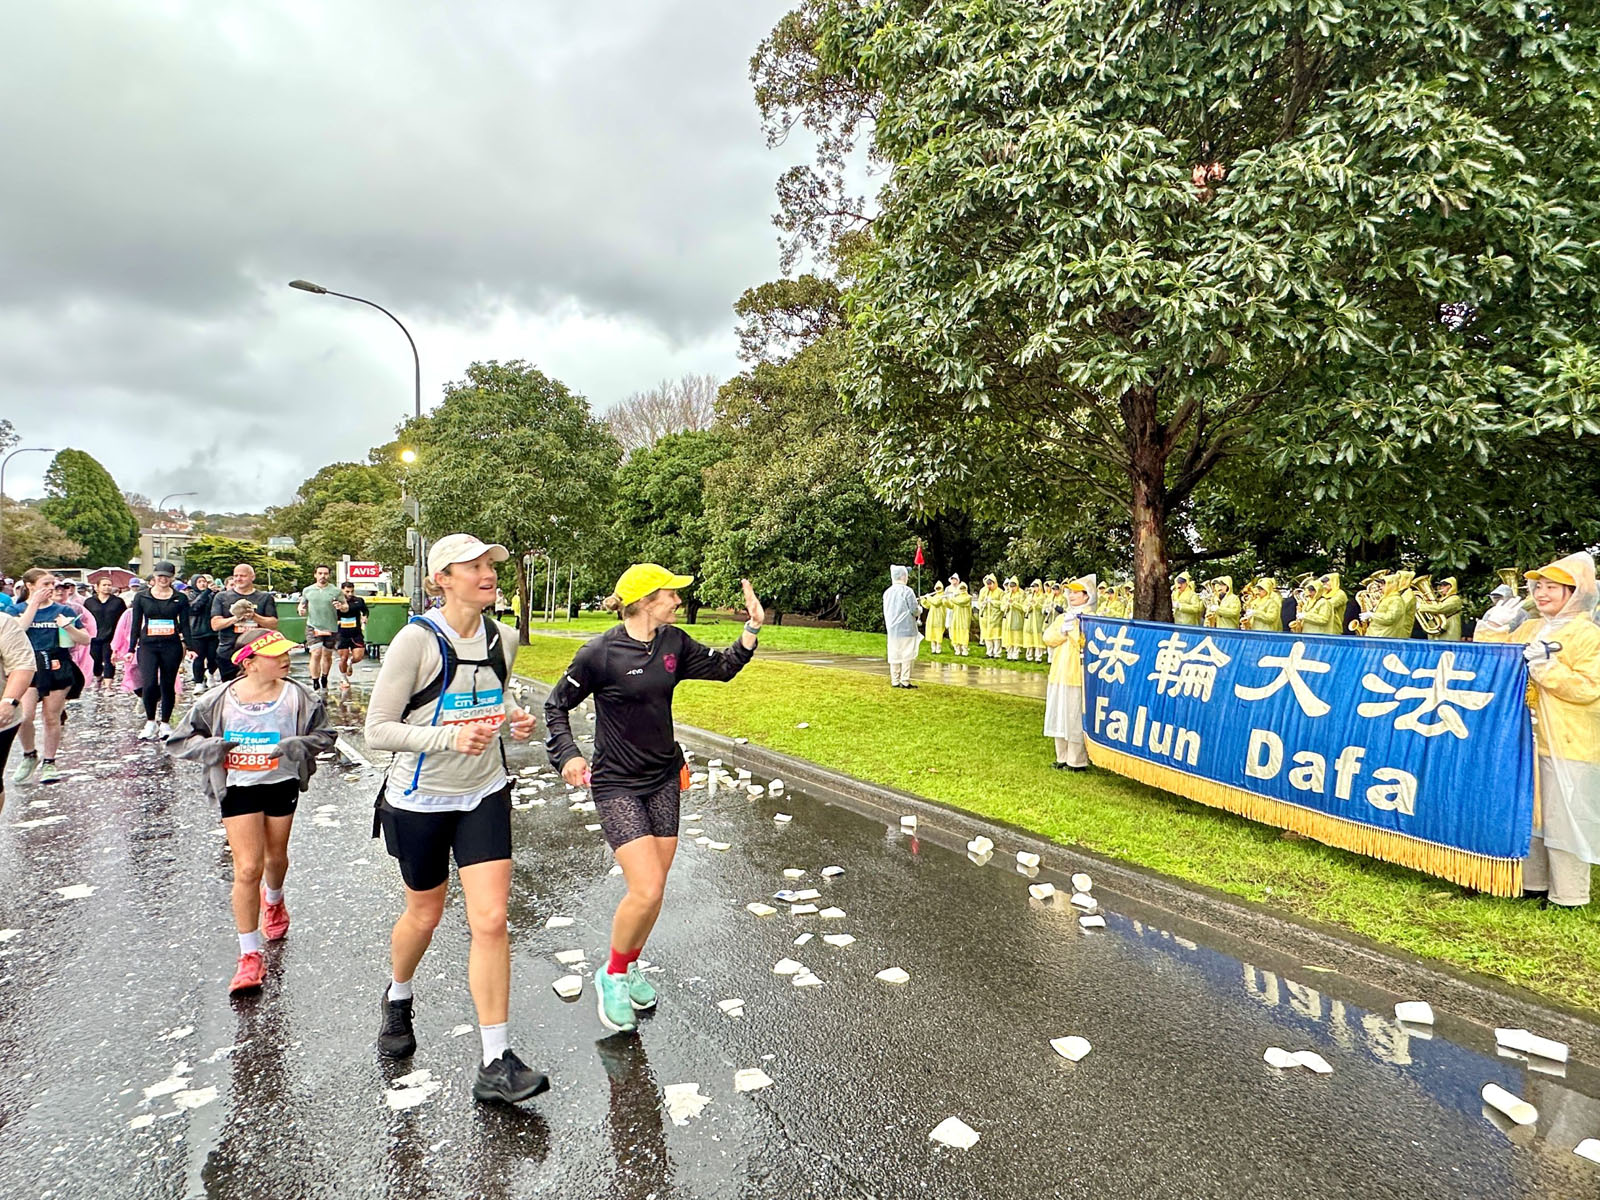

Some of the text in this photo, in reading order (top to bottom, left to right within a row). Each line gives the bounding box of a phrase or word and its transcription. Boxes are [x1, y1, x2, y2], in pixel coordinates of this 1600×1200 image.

[352, 567, 376, 575] AVIS
[1086, 625, 1495, 740] 法輪大法
[1094, 695, 1418, 817] Falun Dafa
